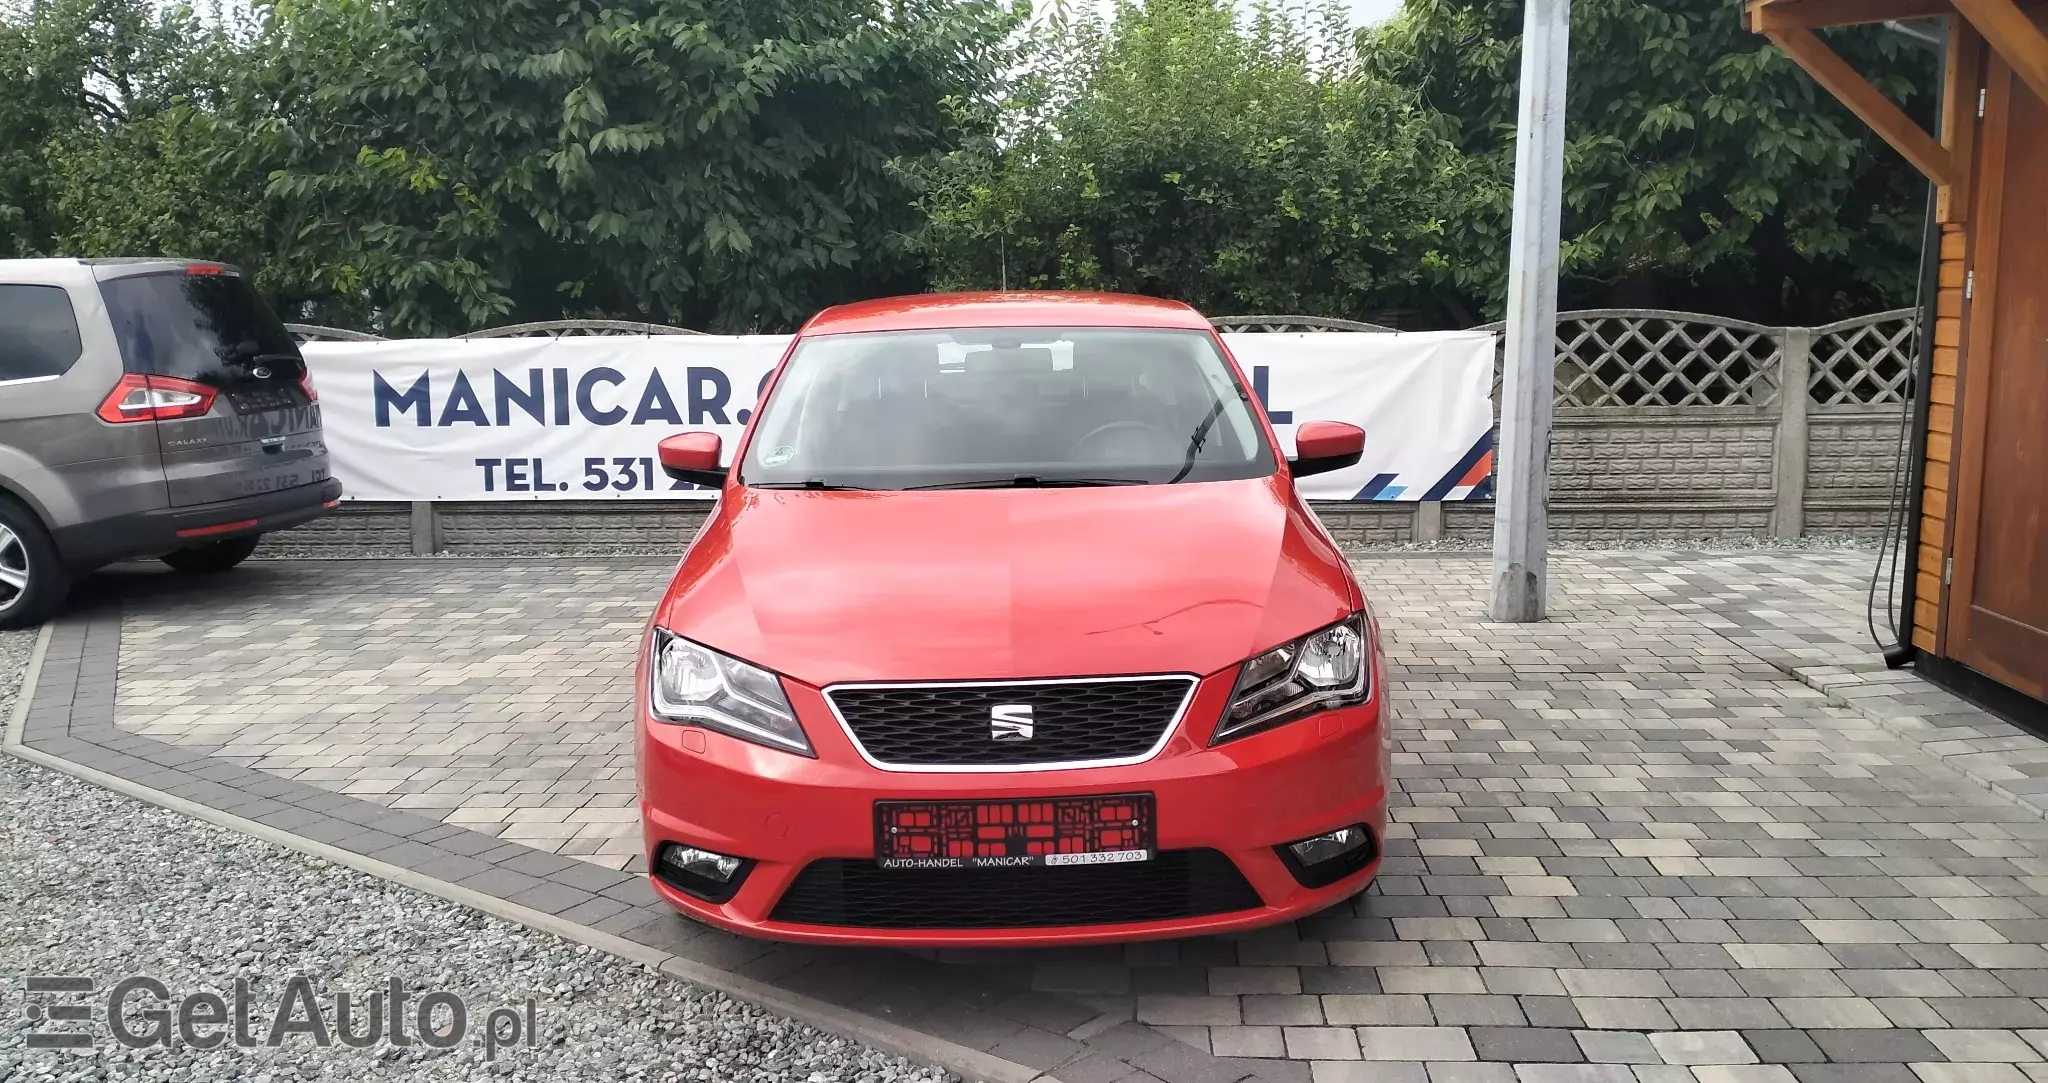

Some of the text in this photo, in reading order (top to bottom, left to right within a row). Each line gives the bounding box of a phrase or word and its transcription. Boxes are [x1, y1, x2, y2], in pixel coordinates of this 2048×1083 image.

[372, 366, 776, 427] MANICAR.
[167, 437, 207, 447] GALAXY
[475, 457, 654, 491] TEL. 531
[883, 851, 1142, 868] AUTO-HANDEL "MANICAR" 501 332 703
